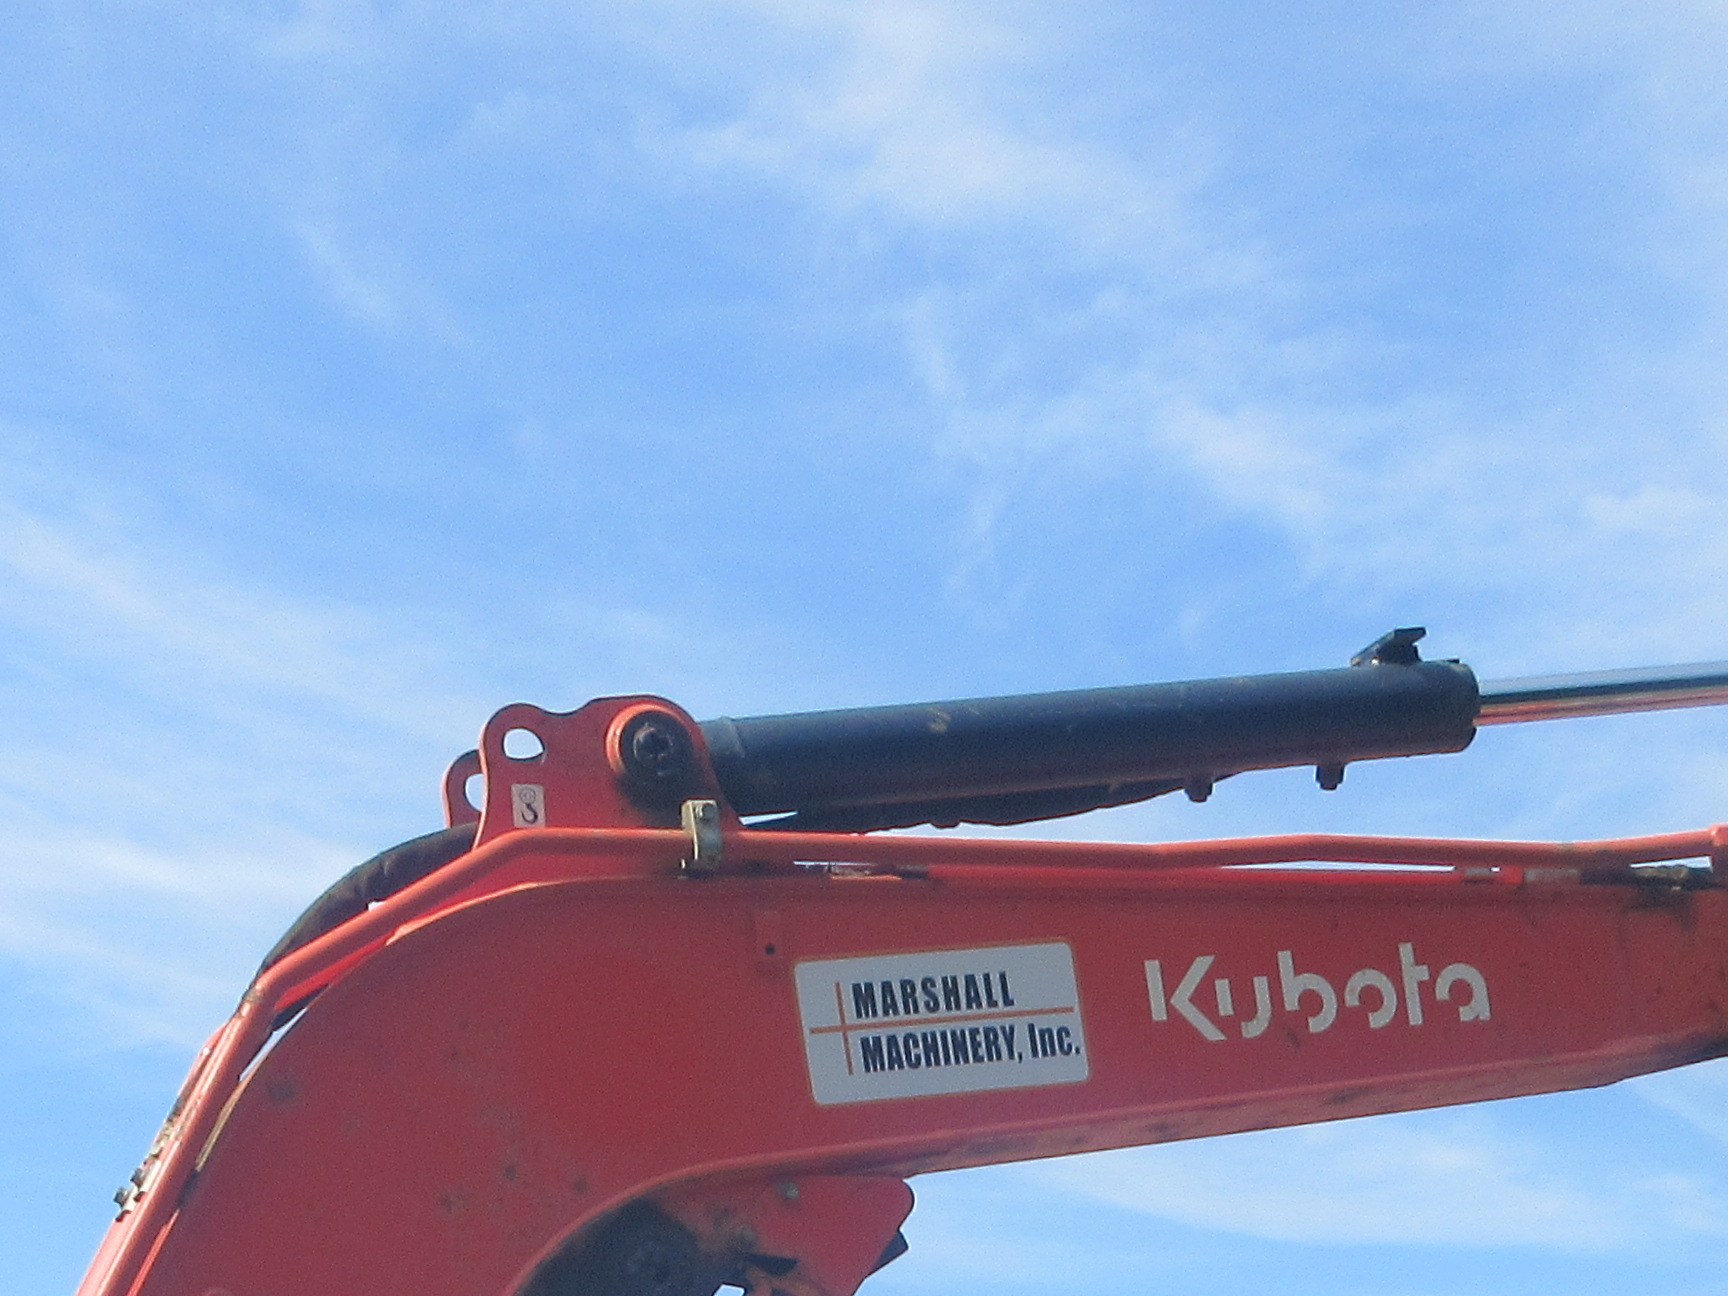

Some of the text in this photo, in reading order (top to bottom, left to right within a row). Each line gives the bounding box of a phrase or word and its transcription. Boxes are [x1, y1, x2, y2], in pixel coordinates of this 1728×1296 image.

[852, 971, 1015, 1019] MARSHALL
[1144, 942, 1491, 1041] Kubota
[860, 1022, 1080, 1074] MACHINERY, Inc.
